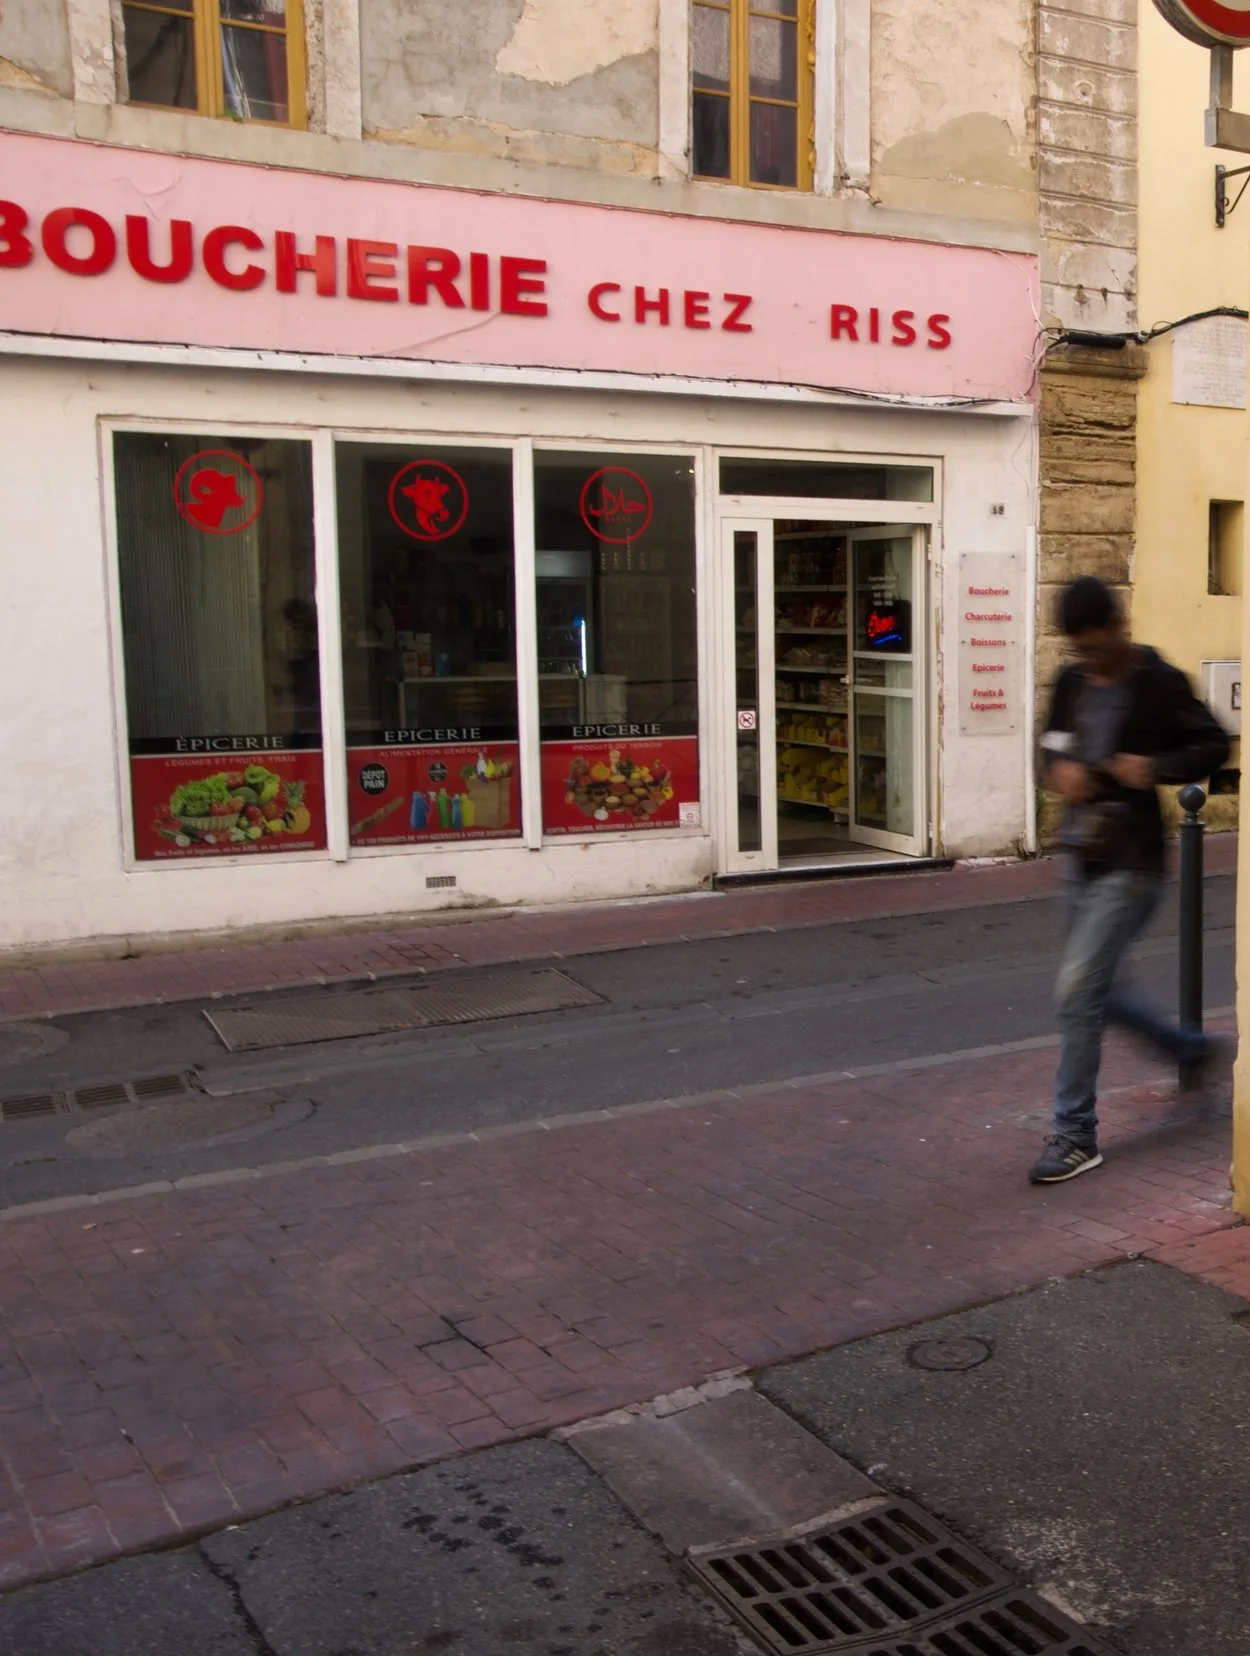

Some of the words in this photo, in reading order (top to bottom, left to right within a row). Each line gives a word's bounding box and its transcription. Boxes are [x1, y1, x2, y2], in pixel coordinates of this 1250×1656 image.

[0, 199, 548, 317] BOUCHERIE
[587, 281, 753, 332] CHEZ
[830, 303, 952, 350] RISS
[589, 483, 647, 516] حلال
[968, 586, 1009, 596] Boucherie
[965, 612, 1013, 621] Charcuterie
[970, 637, 1007, 646] Boissons
[972, 663, 1005, 673] Epicerie
[973, 688, 996, 697] Fruits
[998, 688, 1005, 697] &
[384, 727, 481, 743] EPICERIE
[572, 724, 661, 738] EPICERIE
[363, 779, 386, 789] PAIN
